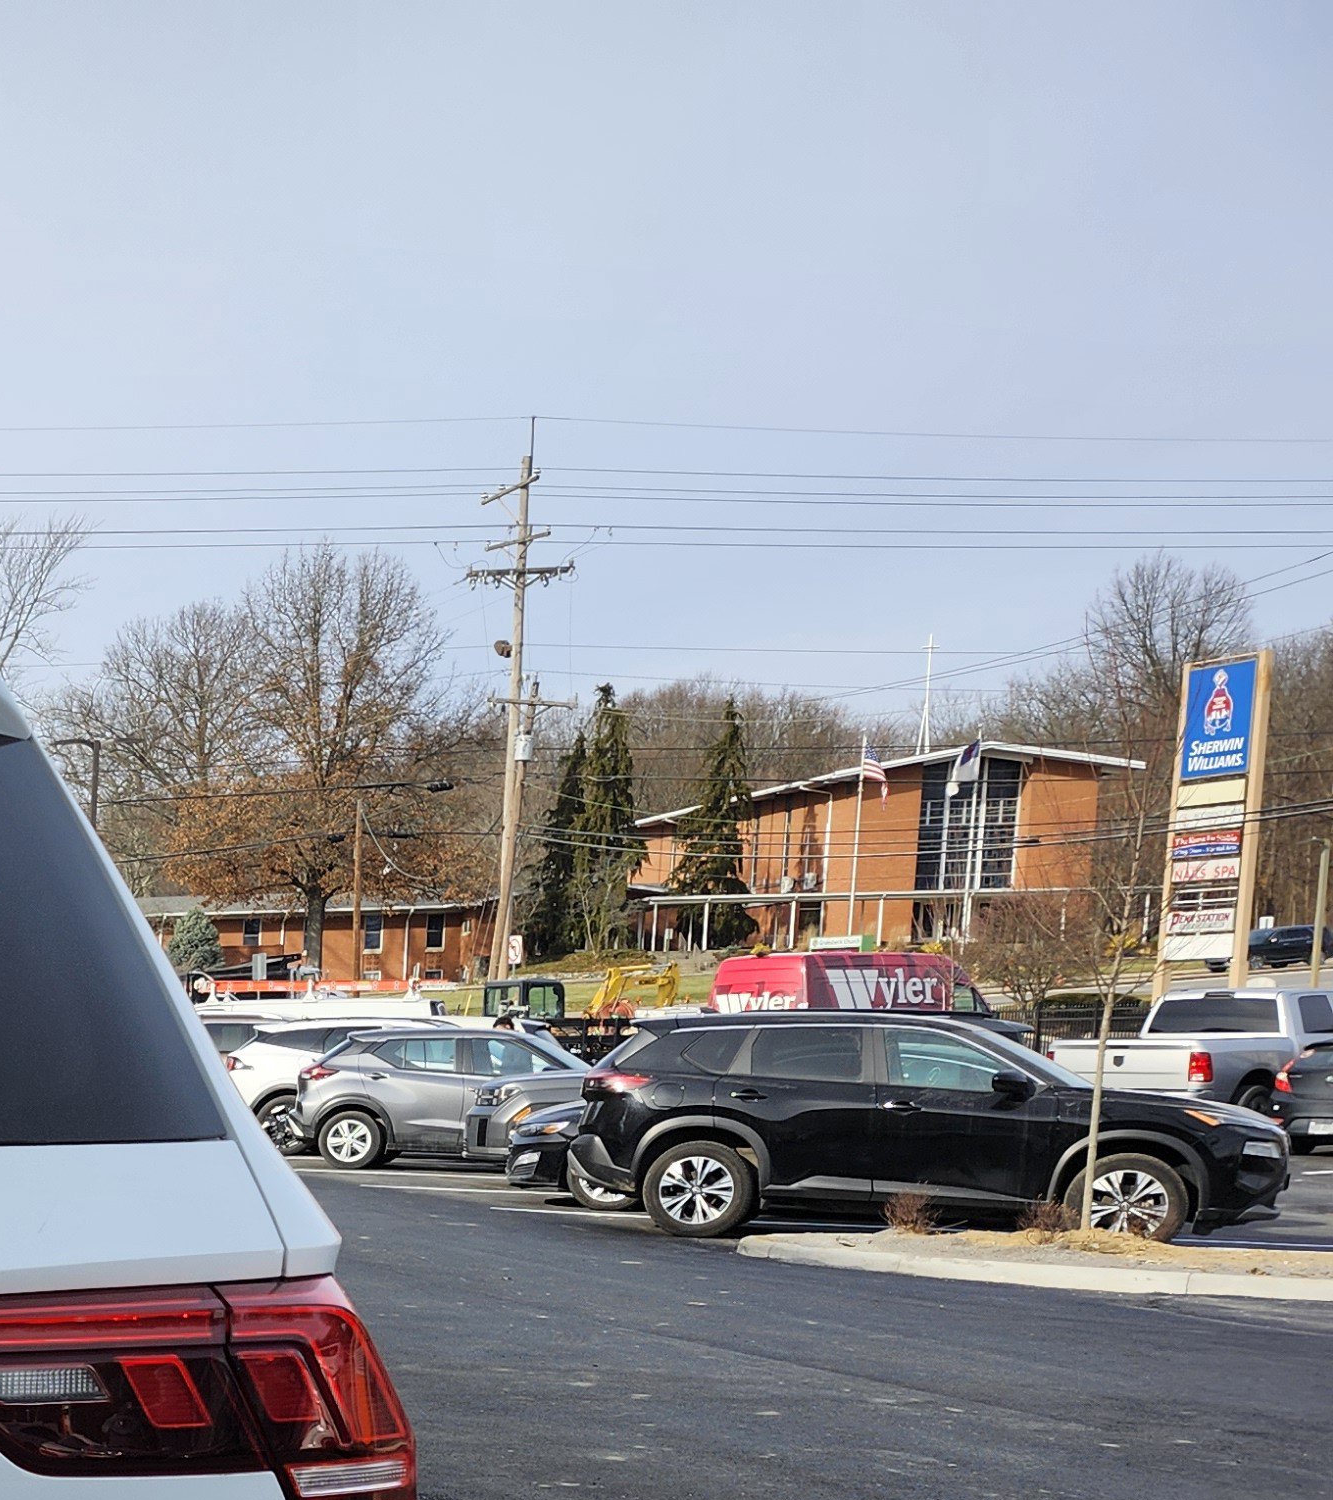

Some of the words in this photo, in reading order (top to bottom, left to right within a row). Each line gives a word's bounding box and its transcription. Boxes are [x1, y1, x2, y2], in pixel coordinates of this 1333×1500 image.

[1189, 737, 1245, 756] SHERWIN
[1188, 753, 1244, 772] WILLIAMS
[1214, 865, 1237, 878] SPA
[1197, 912, 1231, 922] STATION
[826, 968, 937, 1009] Wyler
[716, 991, 796, 1013] Wyler
